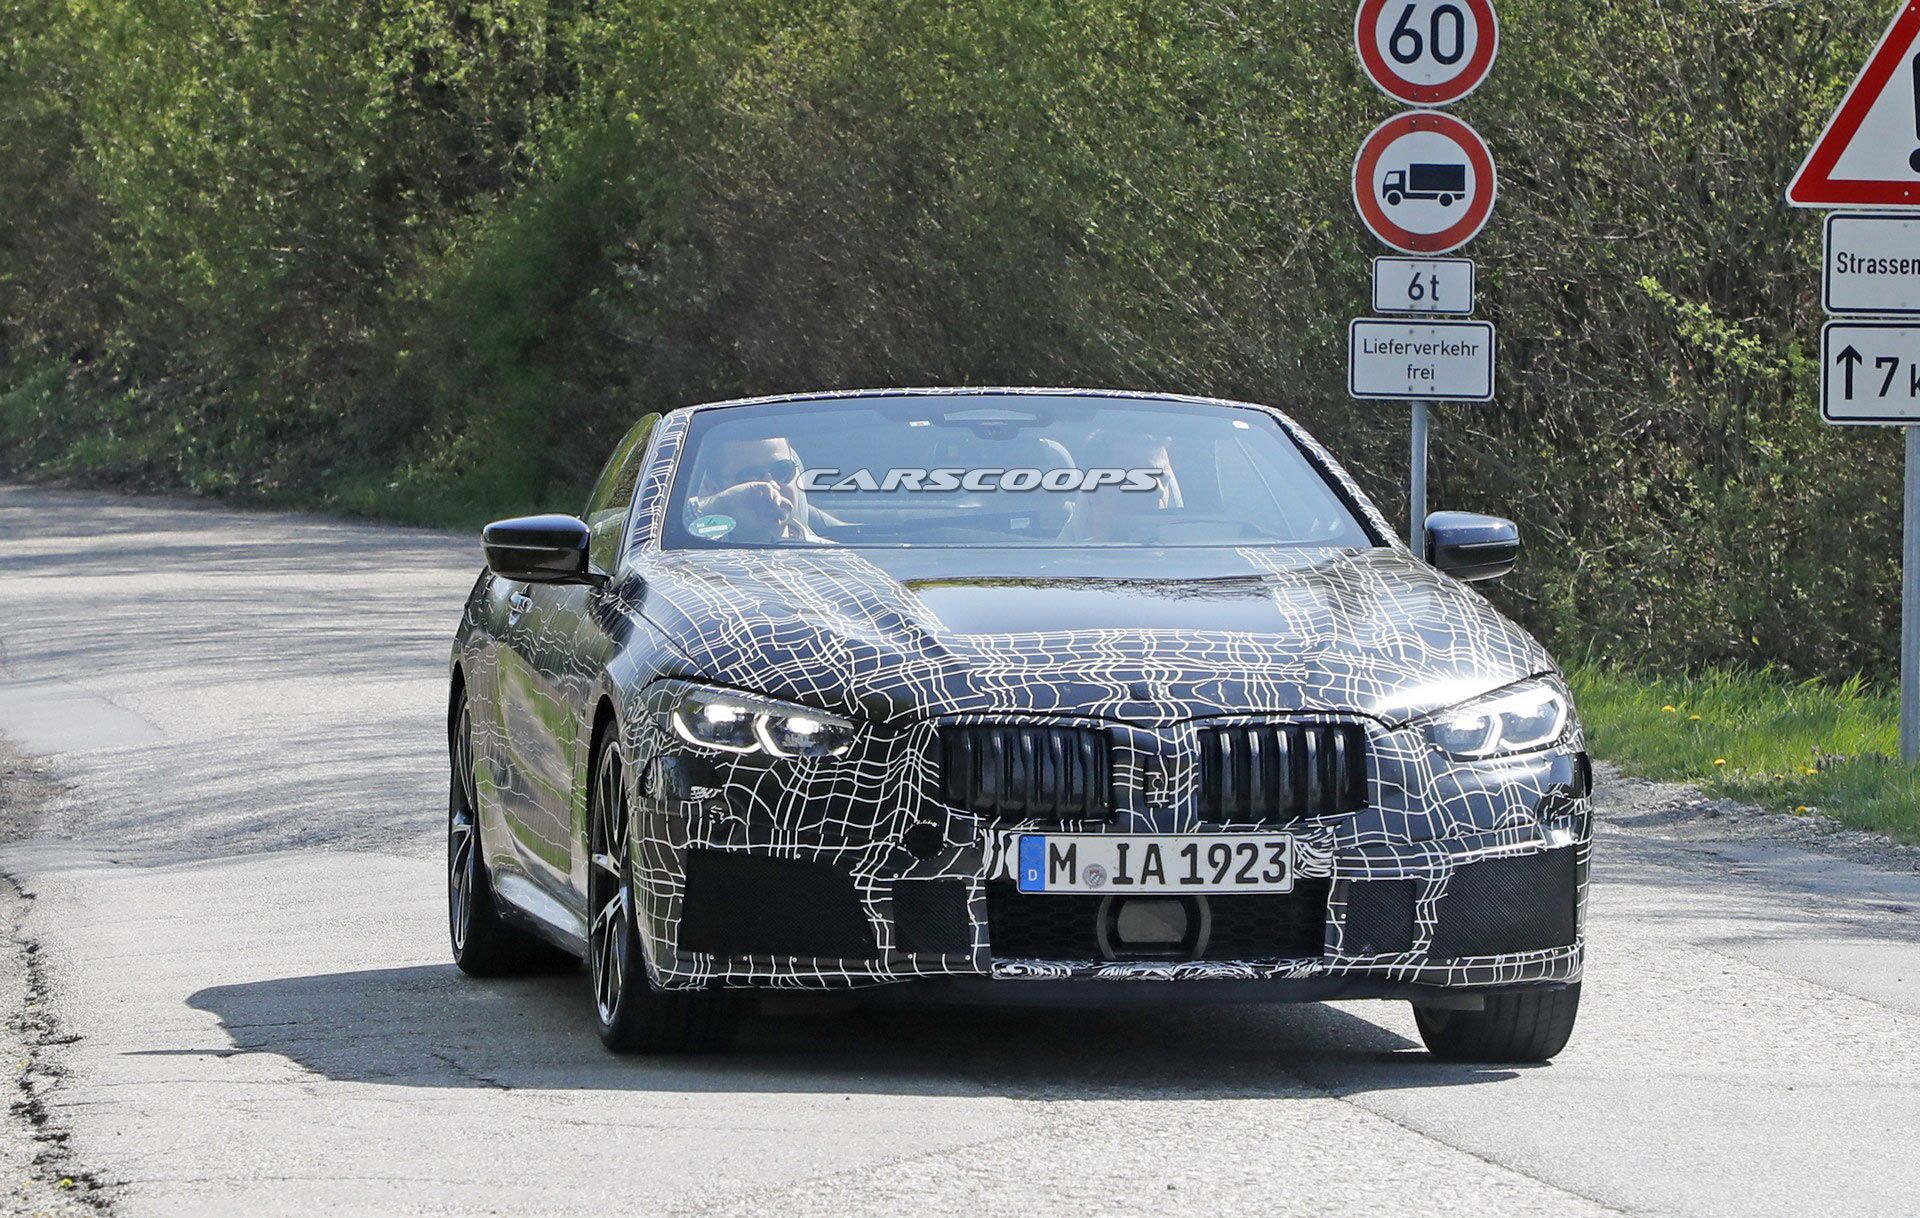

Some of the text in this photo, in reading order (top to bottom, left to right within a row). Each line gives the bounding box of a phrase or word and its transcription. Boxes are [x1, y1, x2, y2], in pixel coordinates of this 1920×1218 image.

[1389, 3, 1465, 65] 60
[1363, 338, 1480, 357] Lieferverkehr
[1406, 363, 1435, 380] frei
[1875, 356, 1900, 398] 7
[1028, 869, 1038, 881] D
[1049, 843, 1286, 885] M IA 1923
